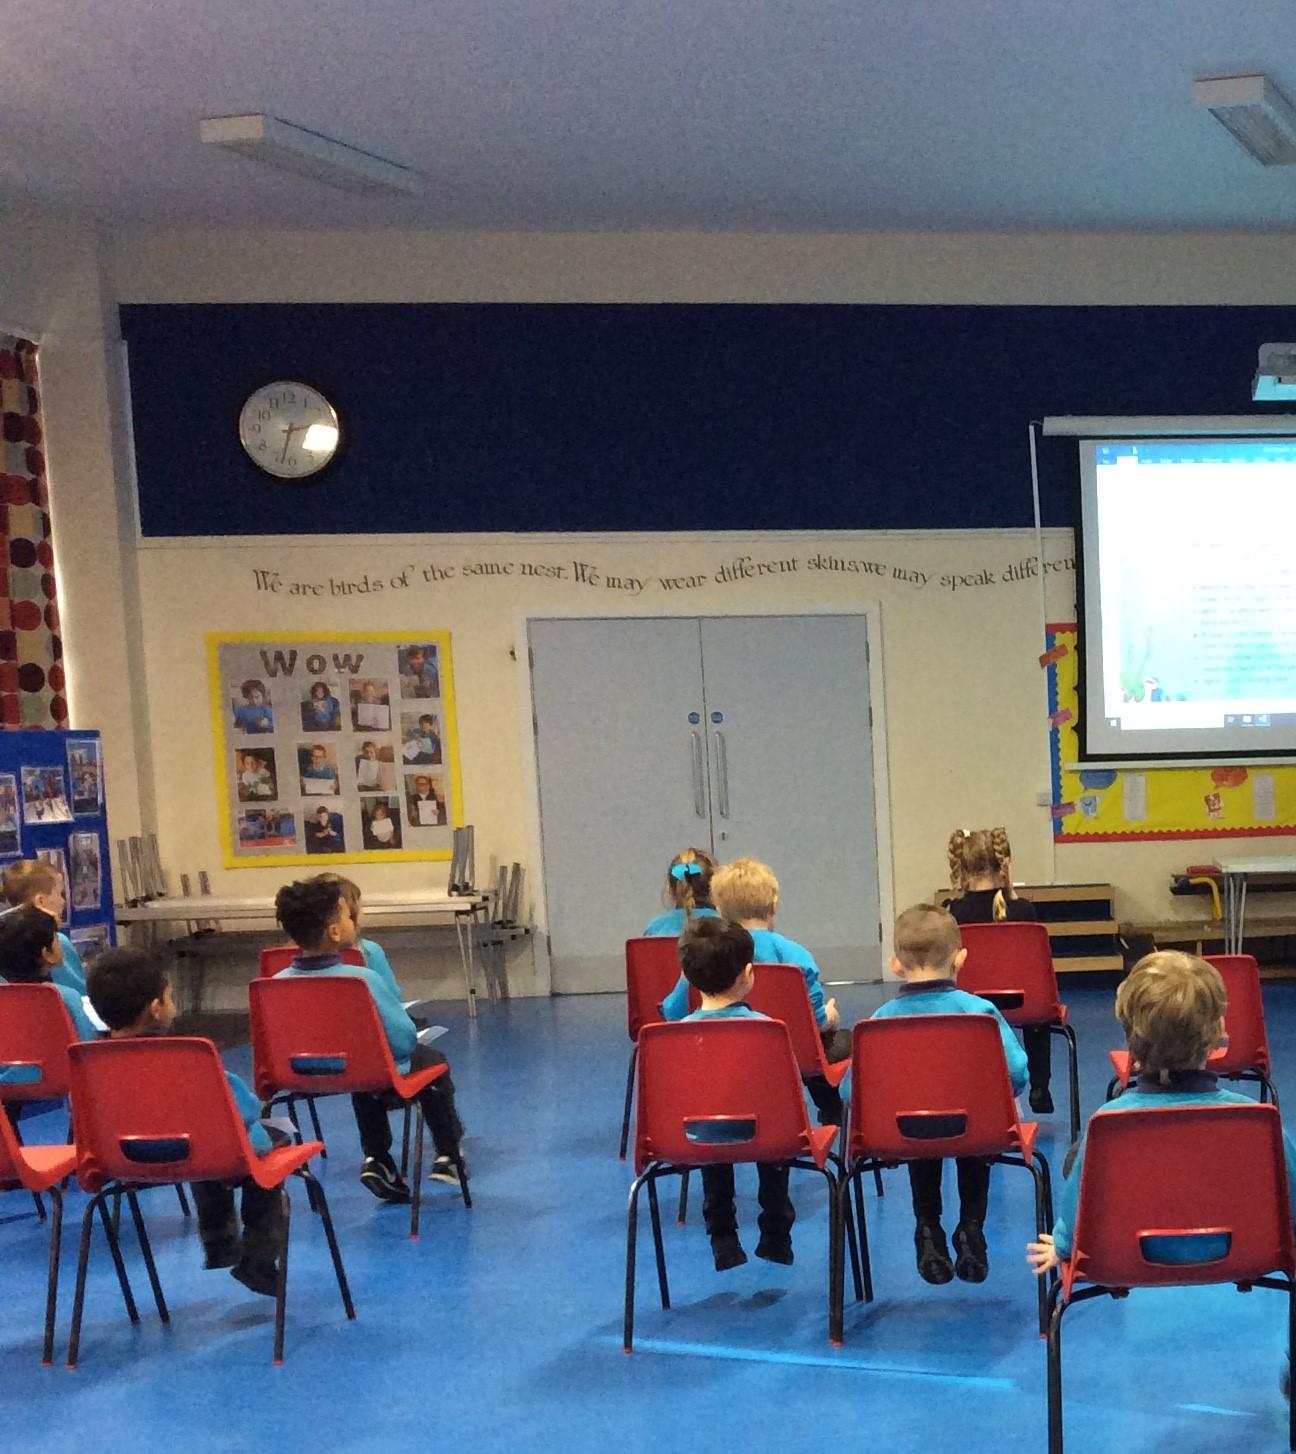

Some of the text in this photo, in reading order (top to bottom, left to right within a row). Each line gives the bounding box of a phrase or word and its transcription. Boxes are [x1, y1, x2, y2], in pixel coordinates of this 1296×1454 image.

[252, 569, 282, 593] We
[289, 581, 324, 596] are
[330, 575, 384, 596] birds
[390, 564, 415, 588] of
[422, 564, 455, 582] the
[462, 562, 514, 577] same
[573, 561, 600, 586] We
[606, 575, 648, 596] may
[659, 574, 707, 590] wear
[714, 556, 799, 584] different
[892, 566, 932, 589] may
[939, 569, 996, 591] speak
